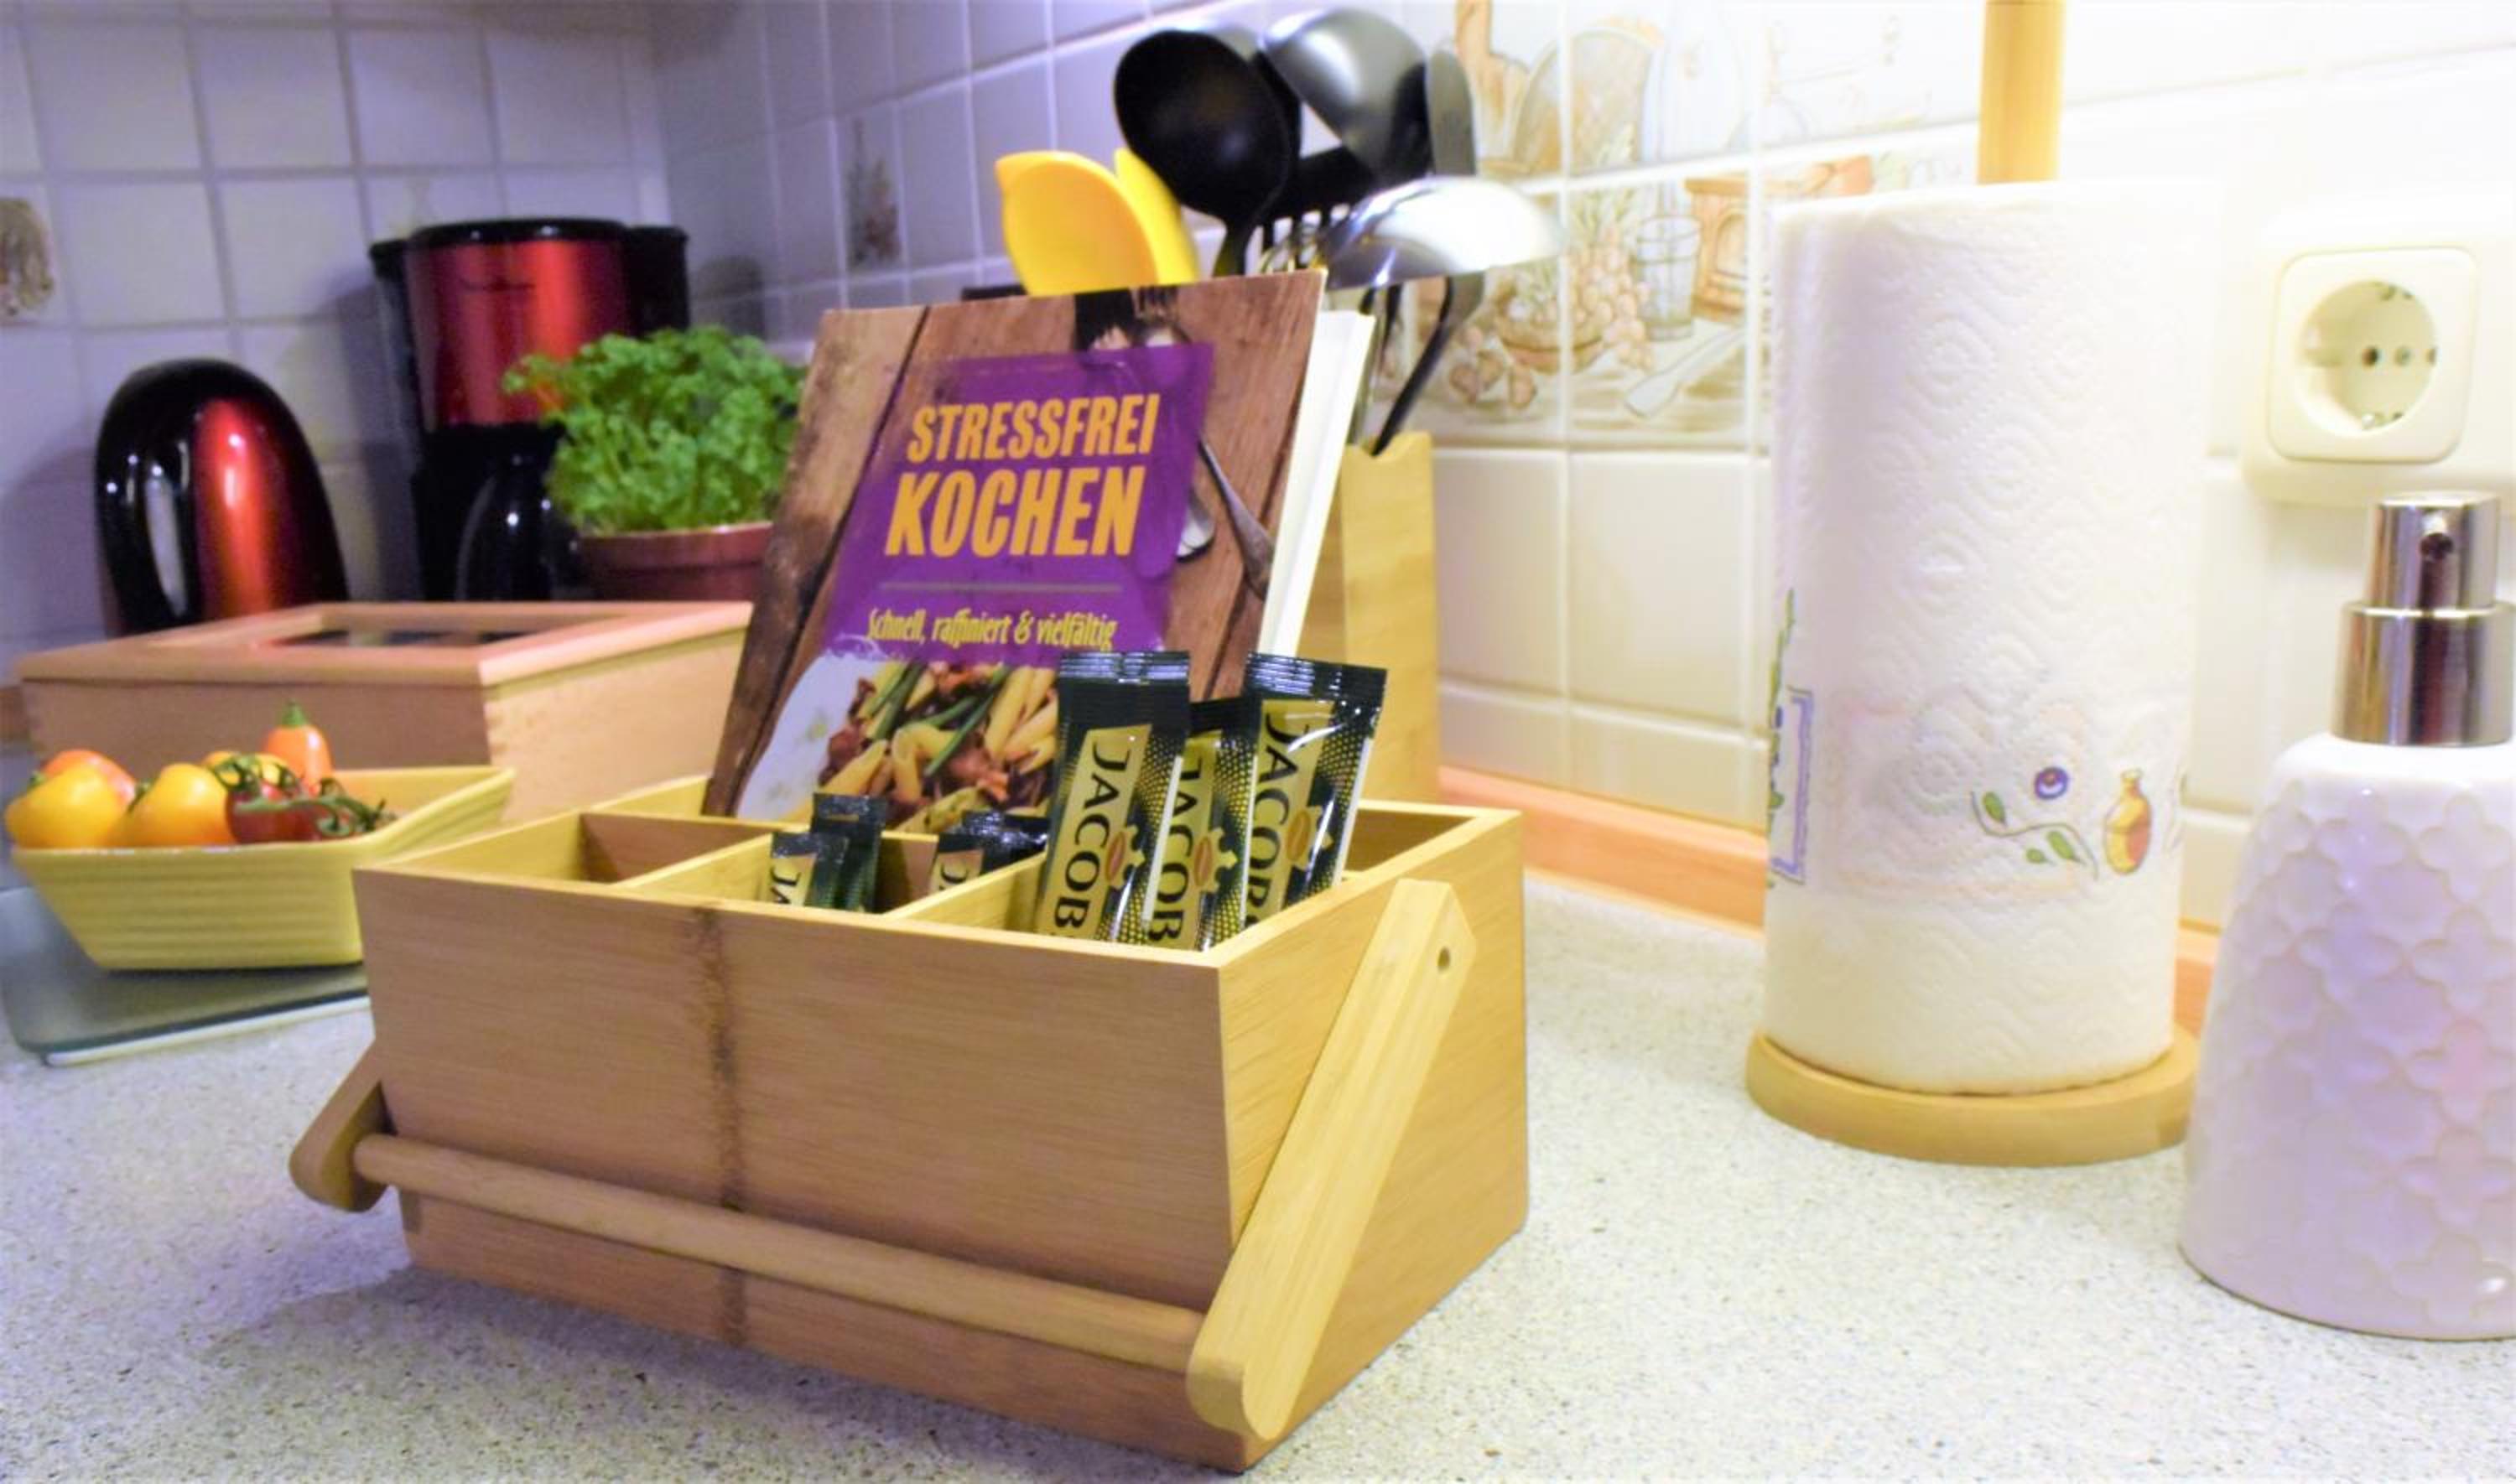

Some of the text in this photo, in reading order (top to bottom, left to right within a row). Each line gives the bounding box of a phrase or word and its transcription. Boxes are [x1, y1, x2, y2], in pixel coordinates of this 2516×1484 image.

[907, 393, 1161, 464] STRESSFREI
[885, 466, 1146, 558] KOCHEN
[932, 608, 1012, 649] raffiniert
[1014, 610, 1035, 645] &
[1037, 612, 1118, 651] vielfältig
[1054, 741, 1131, 937] JACOB
